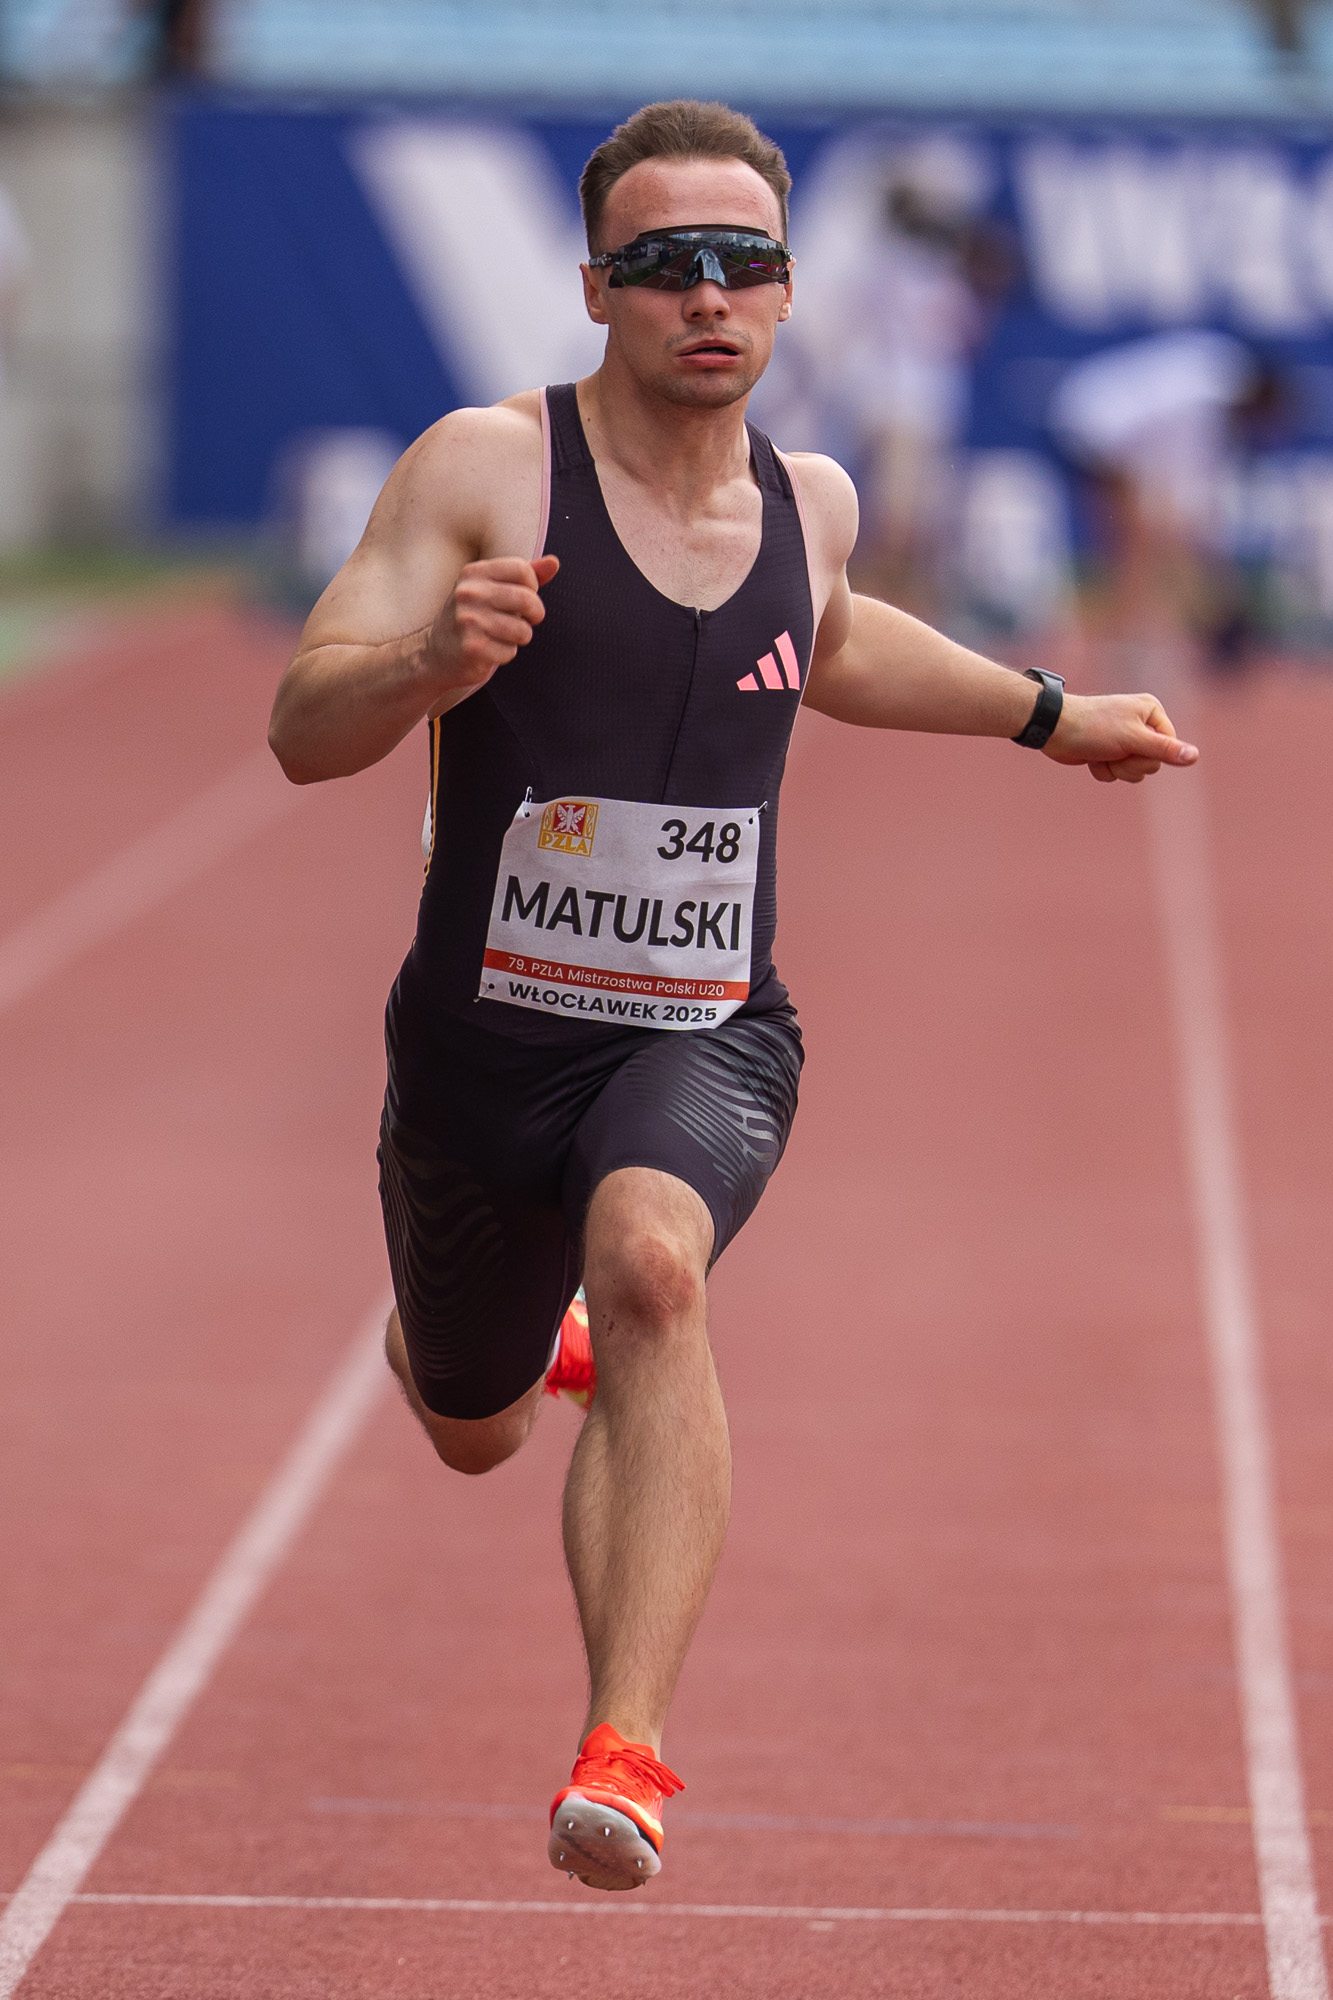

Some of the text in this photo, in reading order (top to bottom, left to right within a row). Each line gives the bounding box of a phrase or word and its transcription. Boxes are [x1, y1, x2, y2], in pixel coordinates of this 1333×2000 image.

[541, 832, 588, 853] PZLA
[656, 819, 741, 864] 348
[501, 875, 742, 951] MATULSKI
[508, 957, 726, 997] 79. PZLA Mistrzostwa Polski U20
[508, 981, 718, 1023] WŁOCŁAWEK 2025
